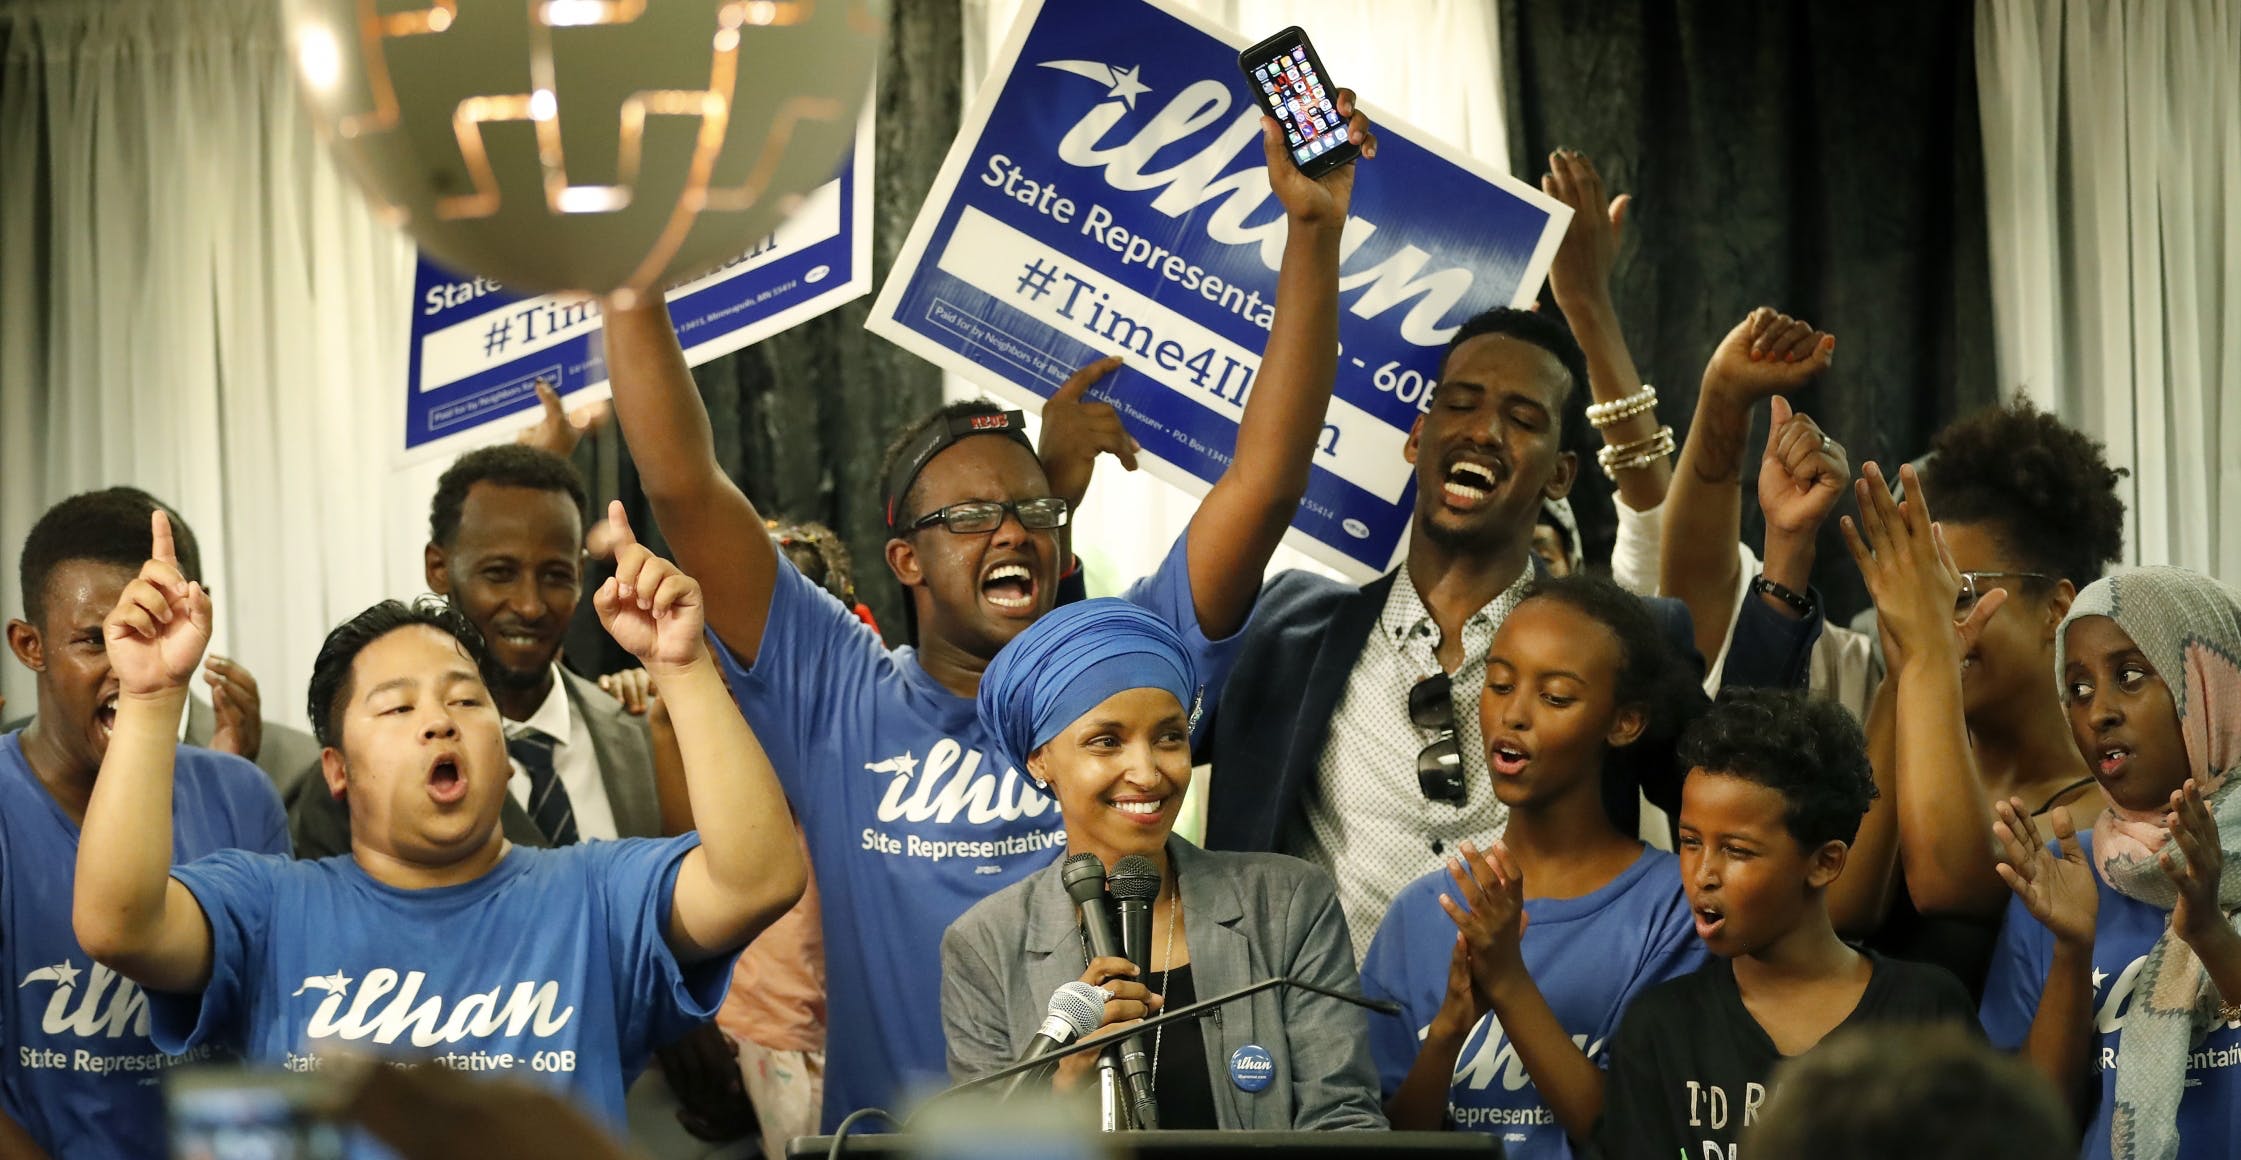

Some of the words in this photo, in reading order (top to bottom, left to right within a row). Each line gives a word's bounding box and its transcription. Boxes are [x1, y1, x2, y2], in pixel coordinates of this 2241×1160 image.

[981, 154, 1076, 224] State
[1081, 204, 1343, 356] Representa
[935, 306, 957, 323] Paid
[957, 316, 972, 331] for
[971, 324, 983, 339] by
[984, 332, 1031, 364] Neighbors
[1032, 356, 1048, 370] for
[1016, 258, 1341, 457] #Time4Iln
[1124, 404, 1164, 431] Treasurer
[1188, 438, 1206, 453] Box
[1307, 500, 1335, 520] 55414
[864, 738, 1062, 824] ilha
[907, 829, 1068, 862] Representative
[19, 958, 151, 1038] ilh
[292, 968, 574, 1048] ilhan
[531, 1051, 576, 1072] 60B
[1235, 1056, 1272, 1071] ilhan
[1448, 1102, 1554, 1128] epresenta
[1686, 1081, 1728, 1130] I'D
